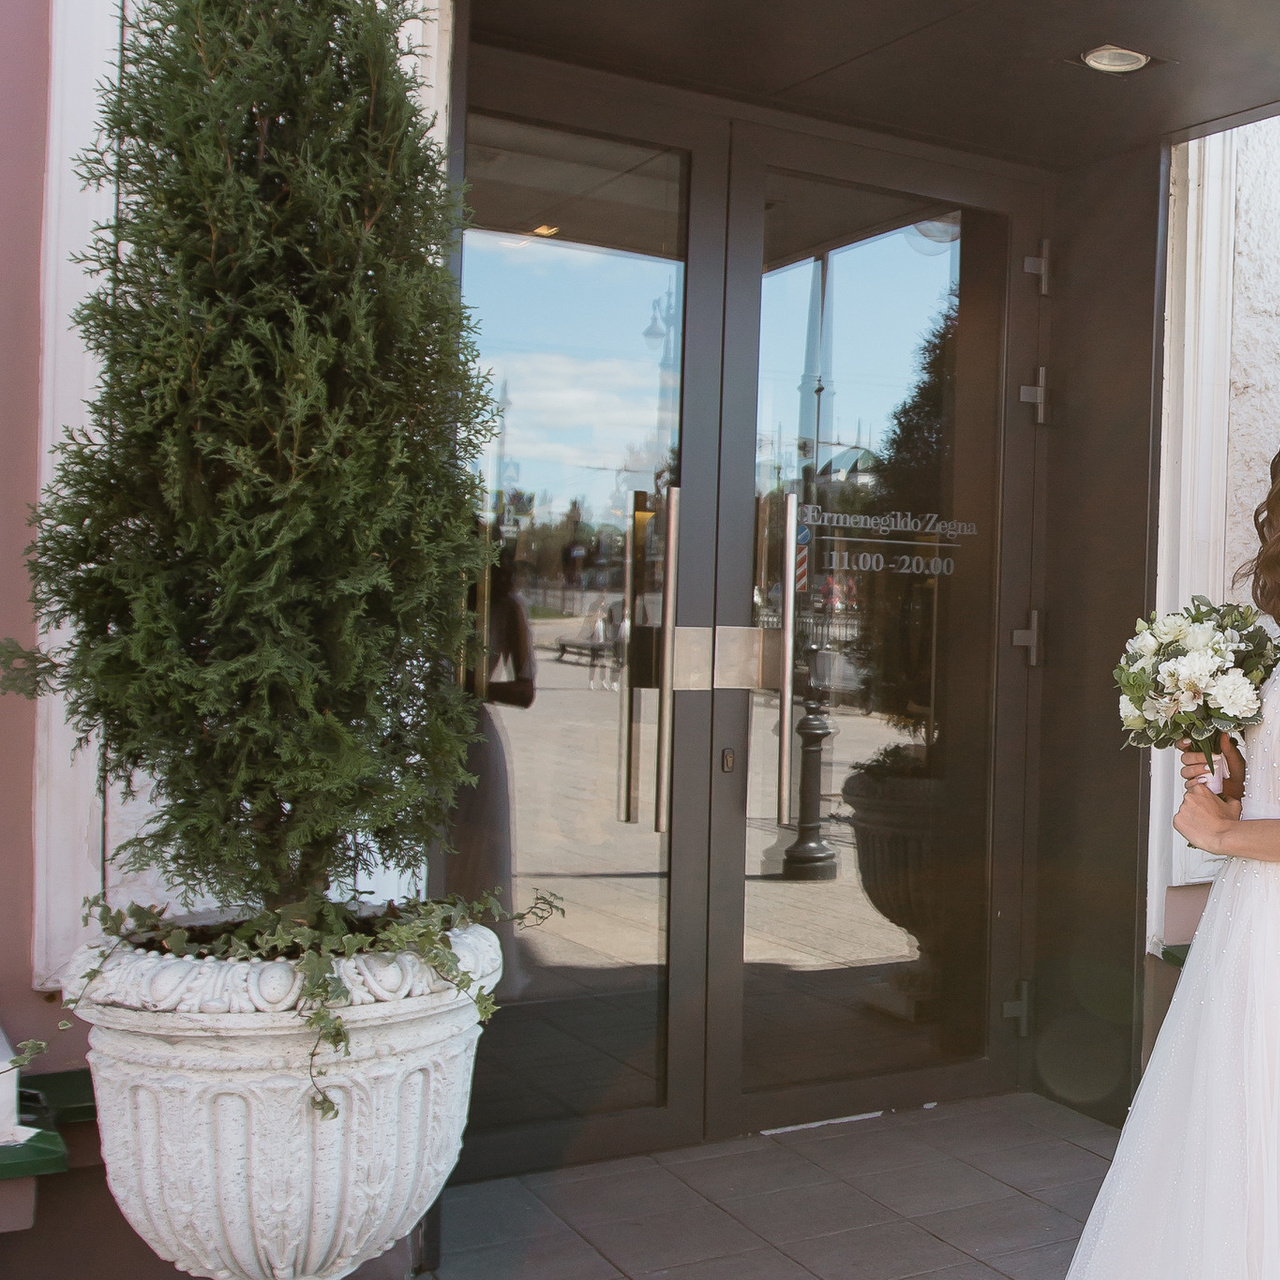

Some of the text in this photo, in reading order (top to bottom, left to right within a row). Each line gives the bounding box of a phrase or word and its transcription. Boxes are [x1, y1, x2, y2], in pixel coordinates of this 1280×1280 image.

[806, 505, 977, 539] Ermenegildo Zegna
[828, 551, 884, 572] 11.00
[899, 555, 955, 575] 20.00
